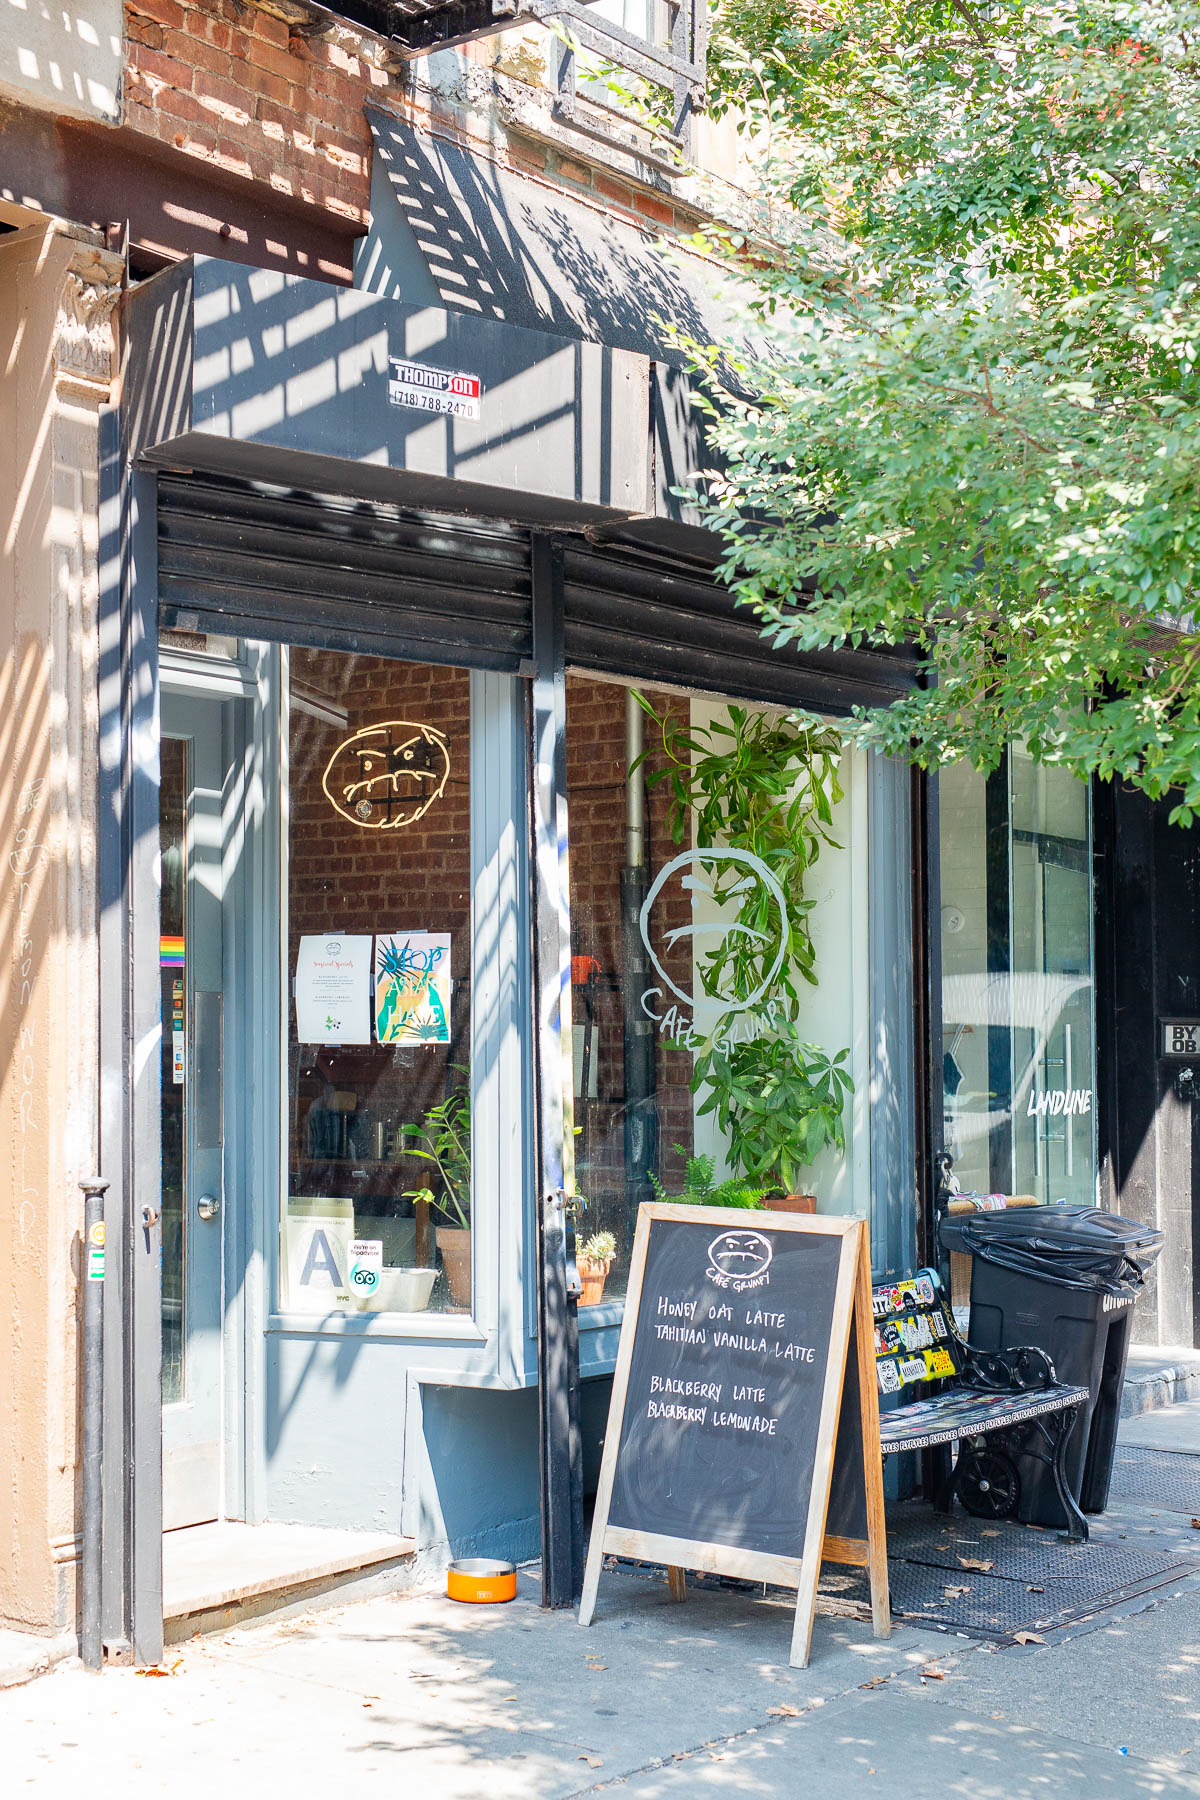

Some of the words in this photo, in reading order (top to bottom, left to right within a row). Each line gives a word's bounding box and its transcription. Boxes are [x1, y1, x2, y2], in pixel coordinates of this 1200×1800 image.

[394, 390, 419, 406] (718)
[421, 395, 473, 417] 788-2470
[385, 947, 443, 973] STOP
[1172, 1026, 1197, 1040] BY
[1172, 1039, 1197, 1053] OB
[1026, 1088, 1093, 1117] LANDLINE
[298, 1229, 344, 1288] A
[732, 1271, 771, 1293] GRUMPY
[708, 1303, 734, 1321] OAT
[745, 1309, 786, 1329] LATTE
[654, 1324, 706, 1345] TAHITIAN
[713, 1331, 767, 1353] VANILLA
[775, 1341, 816, 1363] LATTE
[649, 1375, 722, 1403] BLACKBERRY
[733, 1385, 766, 1403] LATTE
[647, 1399, 707, 1426] BLACKBERRY
[713, 1411, 779, 1435] LEMONADE
